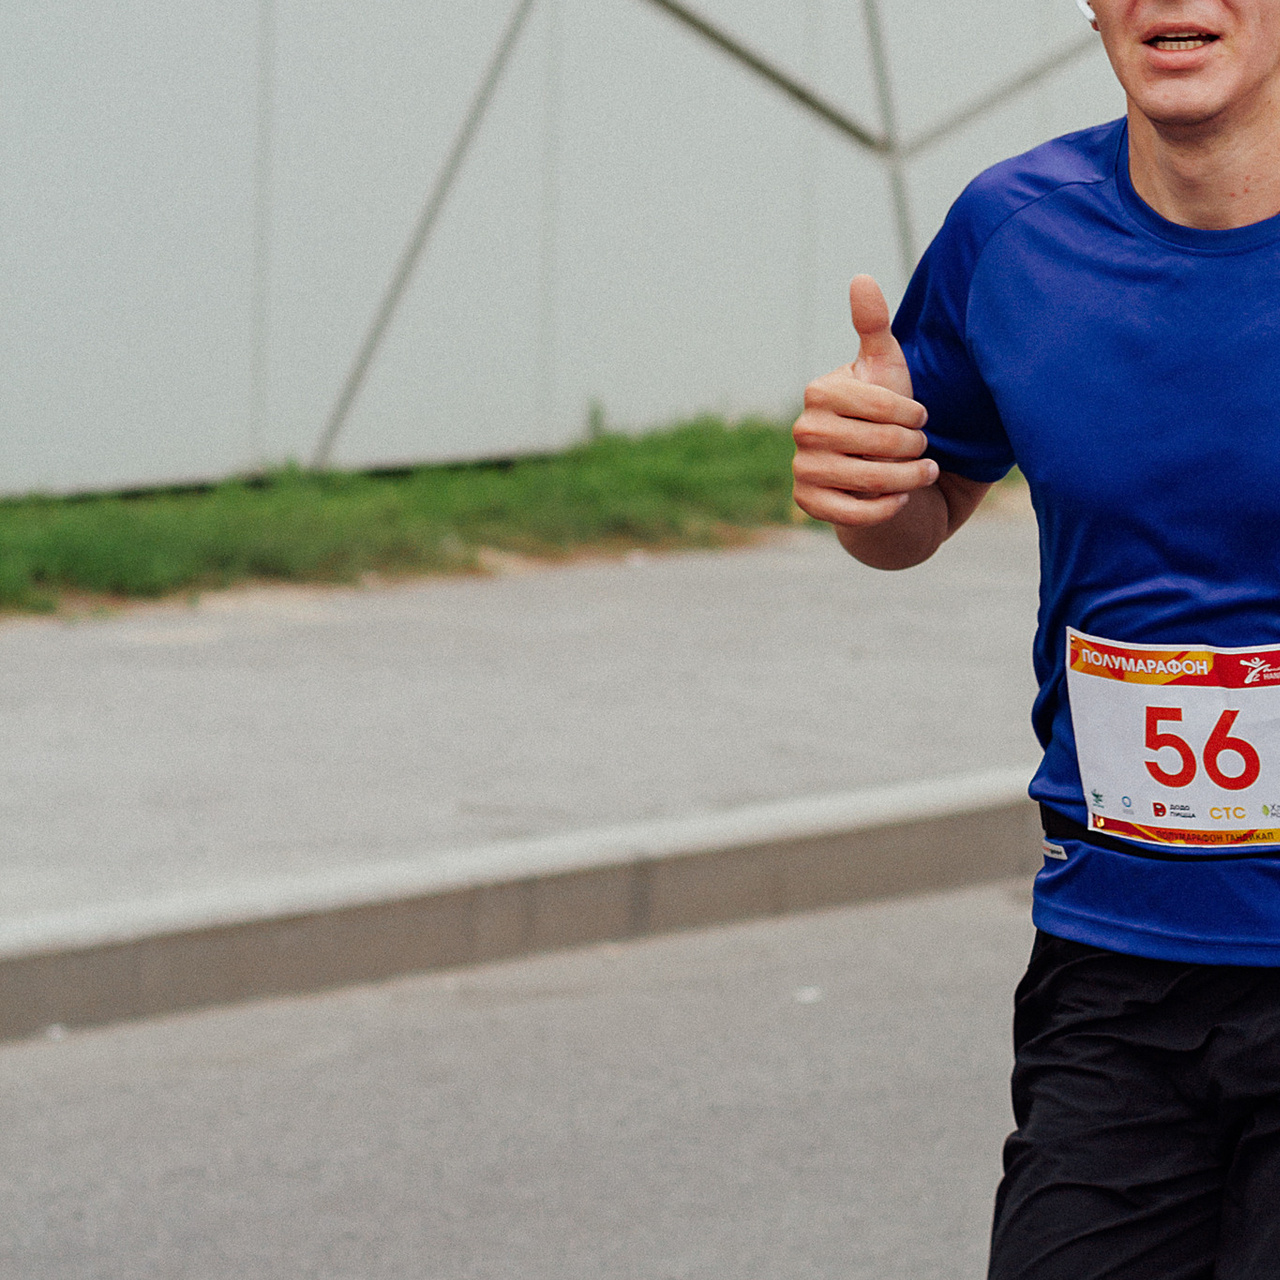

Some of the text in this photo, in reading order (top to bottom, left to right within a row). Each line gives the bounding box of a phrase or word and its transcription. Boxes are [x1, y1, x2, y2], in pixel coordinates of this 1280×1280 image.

[1082, 648, 1208, 675] ПОЛУМАРАФОН
[1145, 706, 1261, 791] 56
[1156, 830, 1274, 843] ПОЛУМАРАФОН ГАНДИКАП
